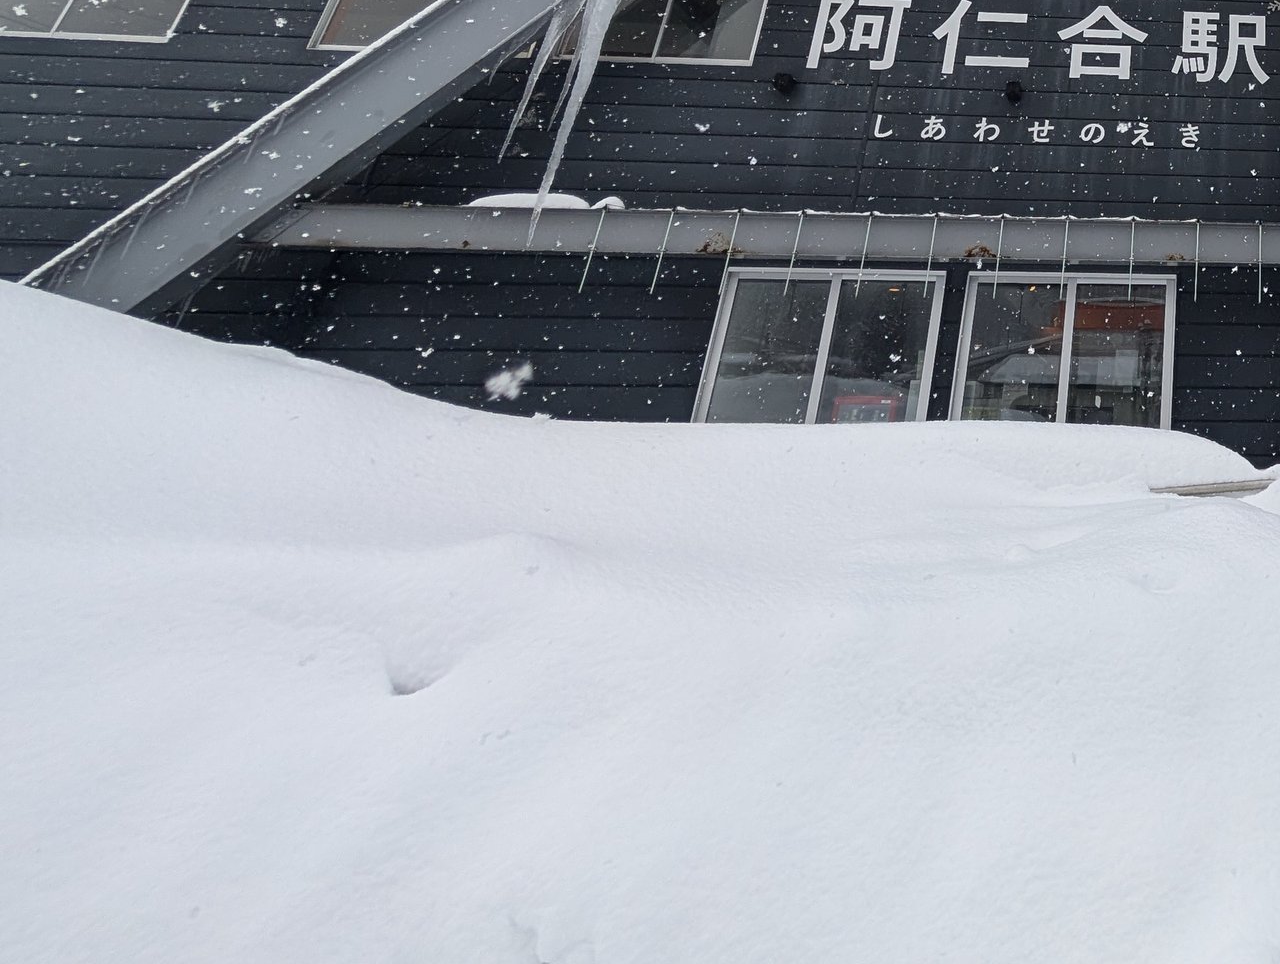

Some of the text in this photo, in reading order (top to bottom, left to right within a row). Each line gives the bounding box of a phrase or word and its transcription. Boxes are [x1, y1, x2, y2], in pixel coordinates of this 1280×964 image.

[873, 114, 1202, 151] しあわせのえき
